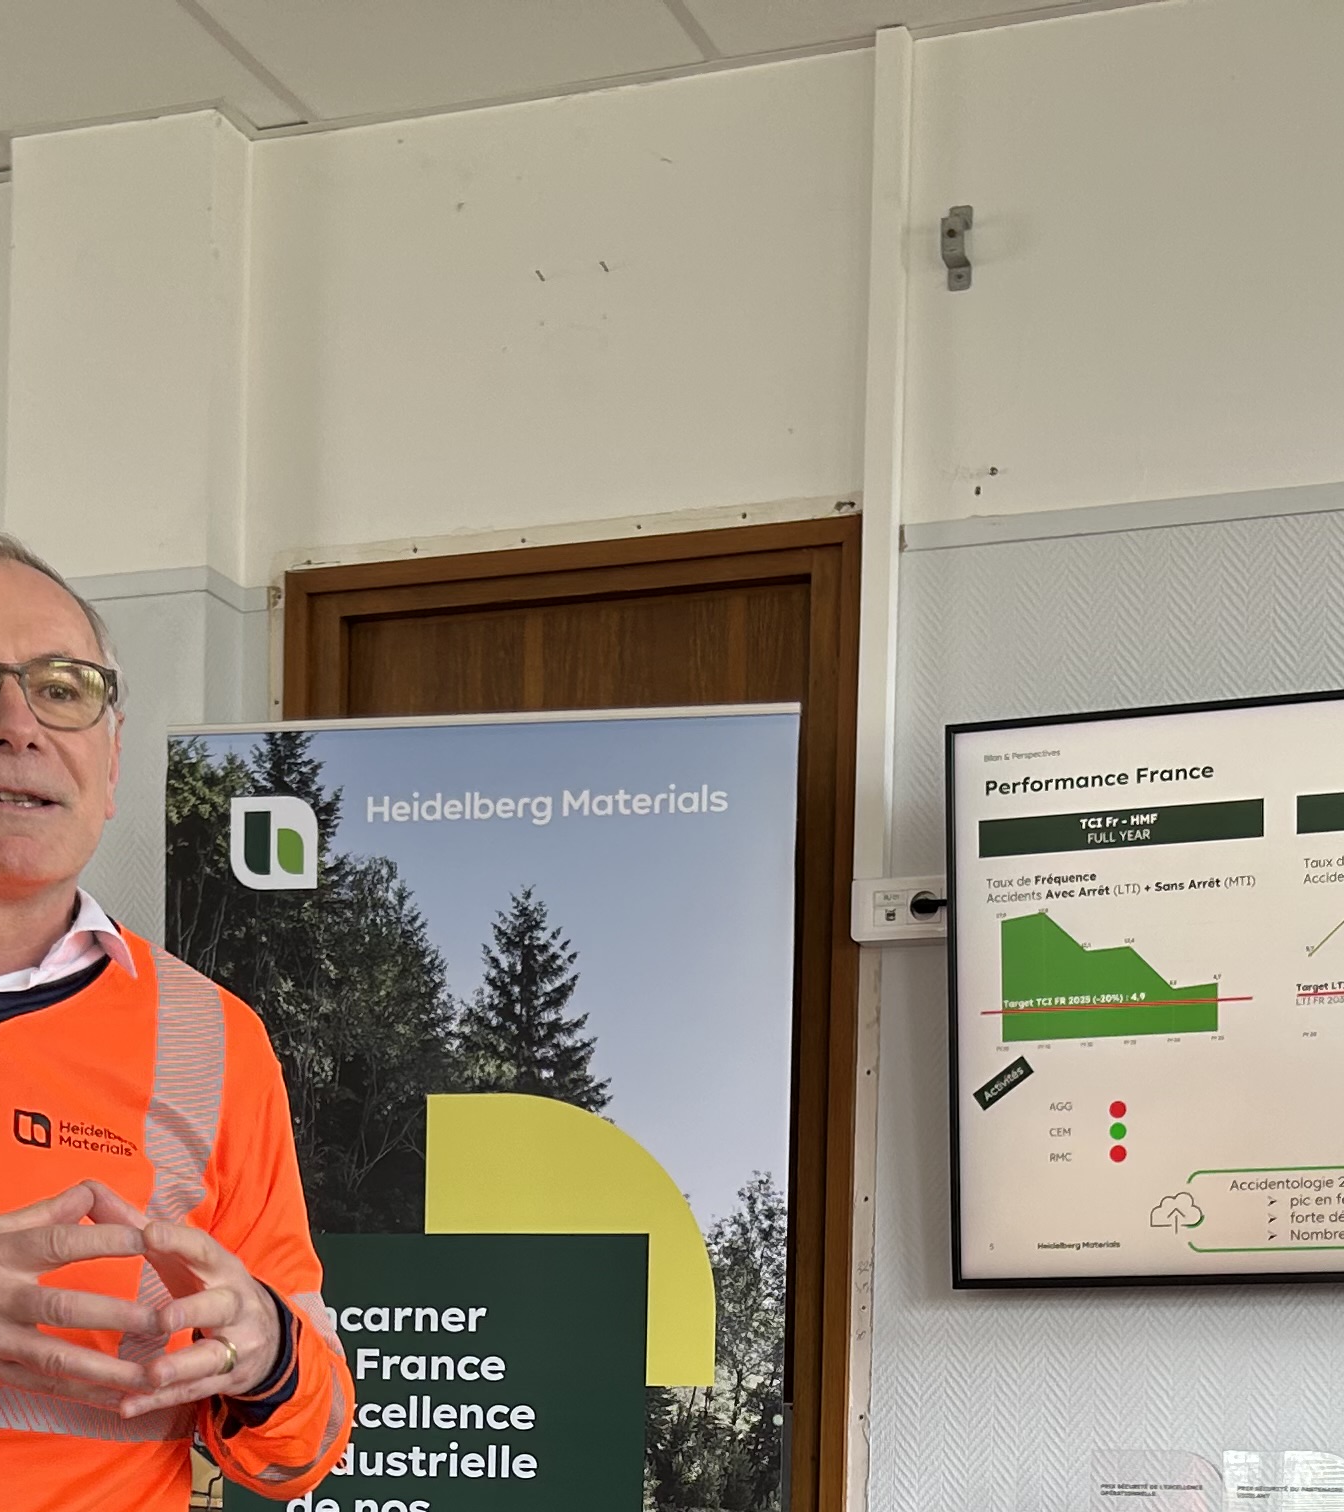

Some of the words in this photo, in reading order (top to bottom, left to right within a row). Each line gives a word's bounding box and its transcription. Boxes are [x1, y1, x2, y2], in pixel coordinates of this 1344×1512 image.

[984, 771, 1129, 796] Performance
[1136, 765, 1215, 784] France
[366, 791, 553, 826] Heidelberg
[561, 784, 729, 818] Materials
[1080, 818, 1103, 830] TCI
[1106, 816, 1119, 828] Fr
[1130, 813, 1158, 826] HMF
[1087, 832, 1116, 844] FULL
[1119, 829, 1151, 842] YEAR
[1304, 857, 1333, 869] Taux
[986, 878, 1014, 890] Taux
[1016, 876, 1032, 887] de
[1034, 872, 1097, 888] Fréquence
[986, 890, 1042, 904] Accidents
[1046, 888, 1075, 900] Avec
[1078, 884, 1110, 898] Arrêt
[1113, 883, 1141, 898] (LTI)
[1154, 881, 1184, 893] Sans
[1188, 877, 1221, 890] Arrêt
[1223, 874, 1256, 889] (MTI)
[1296, 982, 1329, 993] Target
[1004, 999, 1034, 1010] Target
[1036, 997, 1052, 1007] TCI
[1054, 996, 1066, 1006] FR
[984, 1066, 1024, 1102] Activités
[1049, 1101, 1073, 1112] AGG
[1049, 1127, 1072, 1138] CEM
[59, 1135, 133, 1157] Materials
[1049, 1152, 1072, 1163] RMC
[1229, 1176, 1334, 1192] Accidentologie
[1290, 1194, 1310, 1210] pic
[1314, 1196, 1332, 1206] en
[1290, 1211, 1325, 1224] forte
[1038, 1241, 1081, 1250] Heidelberg
[1082, 1240, 1120, 1248] Materials
[325, 1306, 487, 1333] carner
[356, 1348, 506, 1382] France
[352, 1396, 536, 1430] cellence
[330, 1442, 538, 1480] dustrielle
